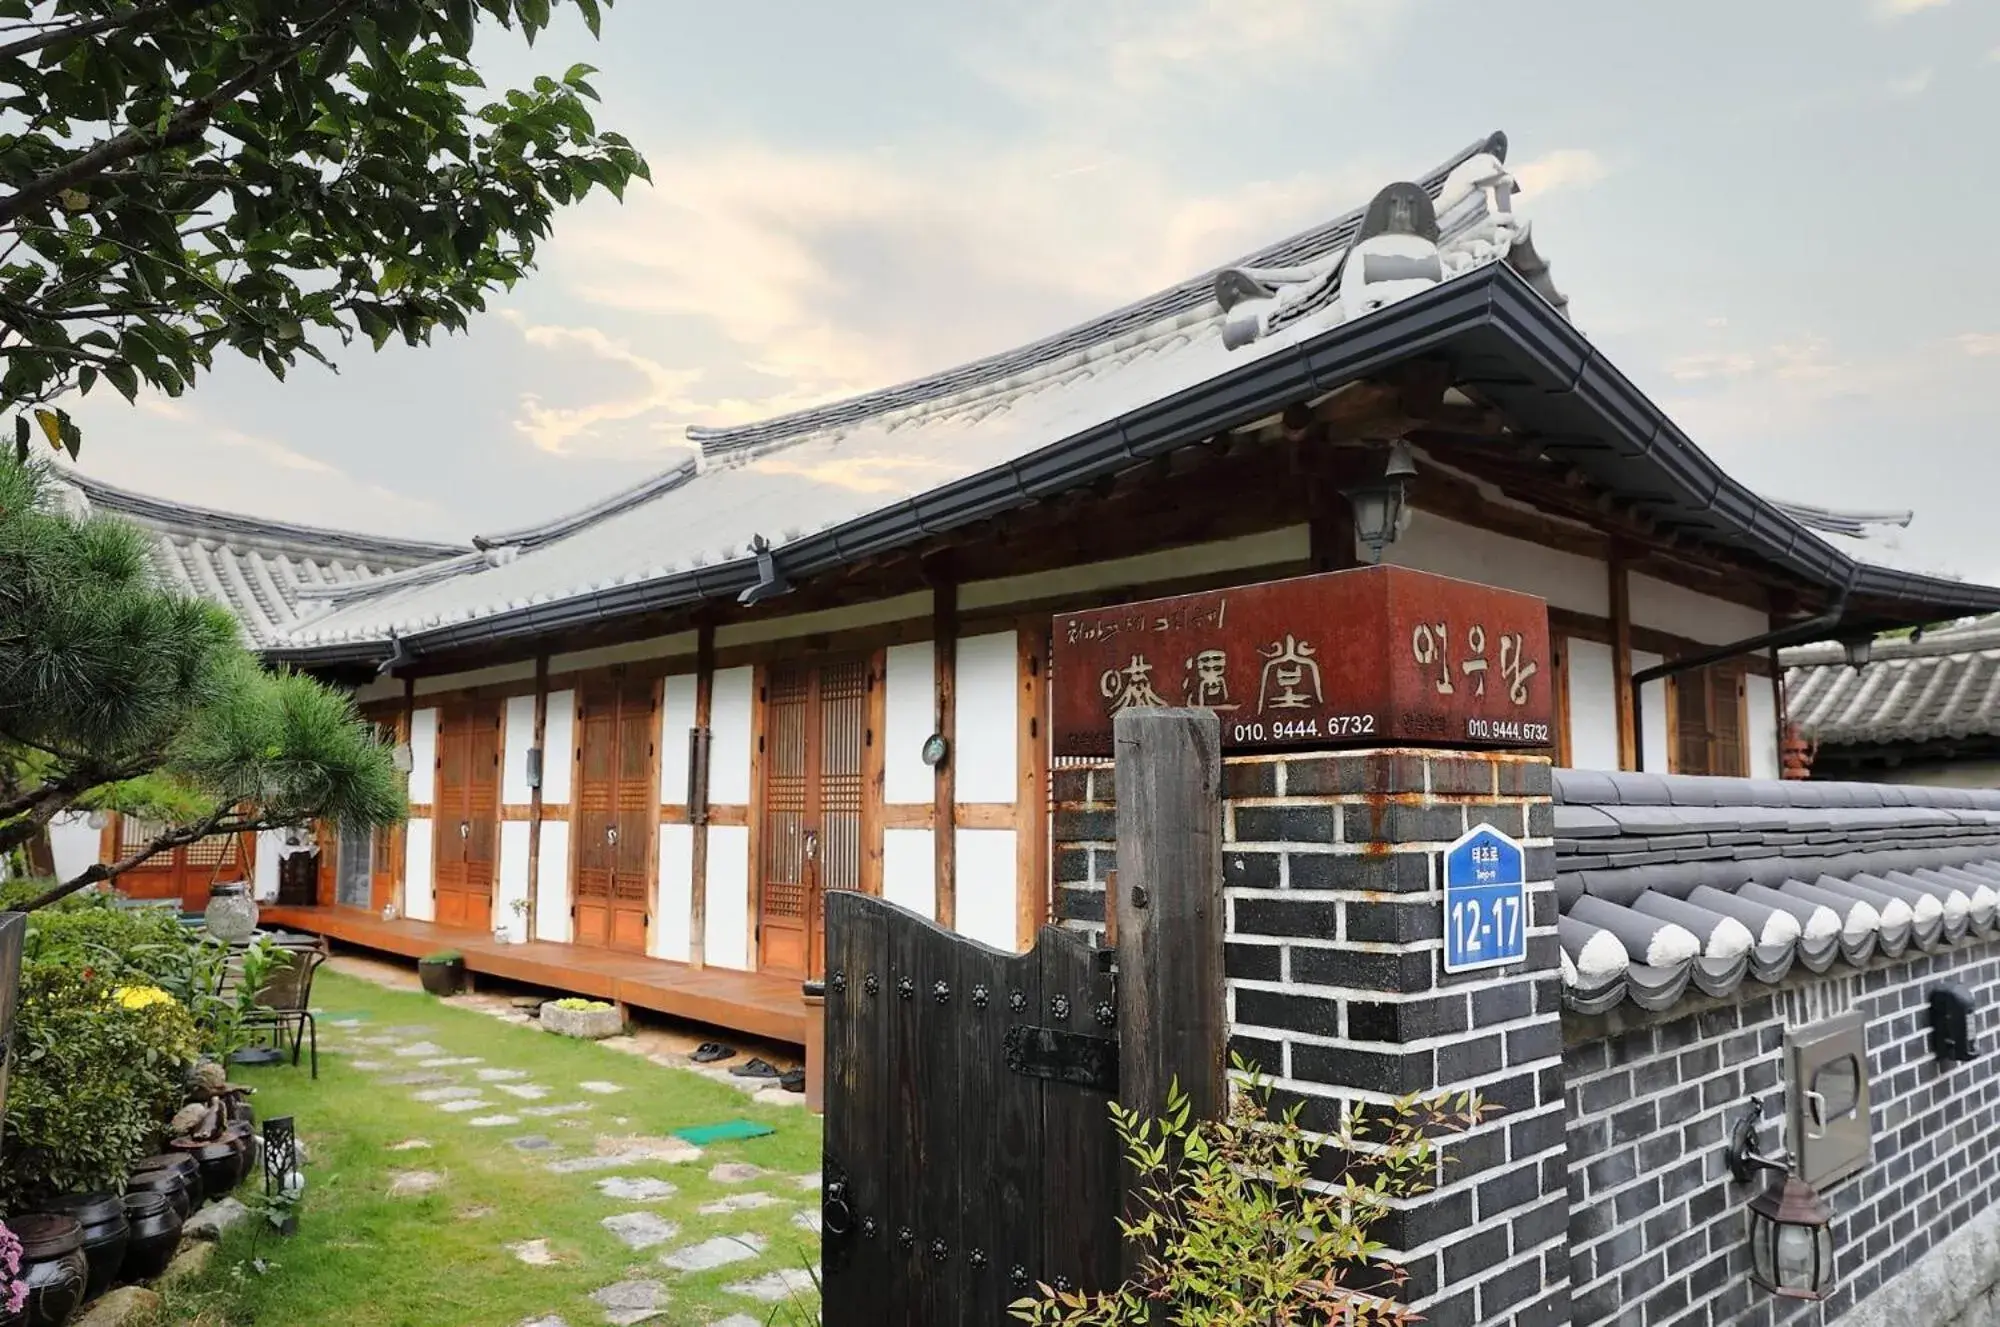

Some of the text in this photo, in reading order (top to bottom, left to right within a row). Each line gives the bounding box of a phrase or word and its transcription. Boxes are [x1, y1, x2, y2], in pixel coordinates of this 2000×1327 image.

[1234, 714, 1375, 742] 010. 9444. 6732
[1468, 719, 1490, 738] 010.
[1493, 720, 1521, 740] 9444.
[1523, 723, 1548, 741] 6732
[1452, 896, 1520, 954] 12-17
